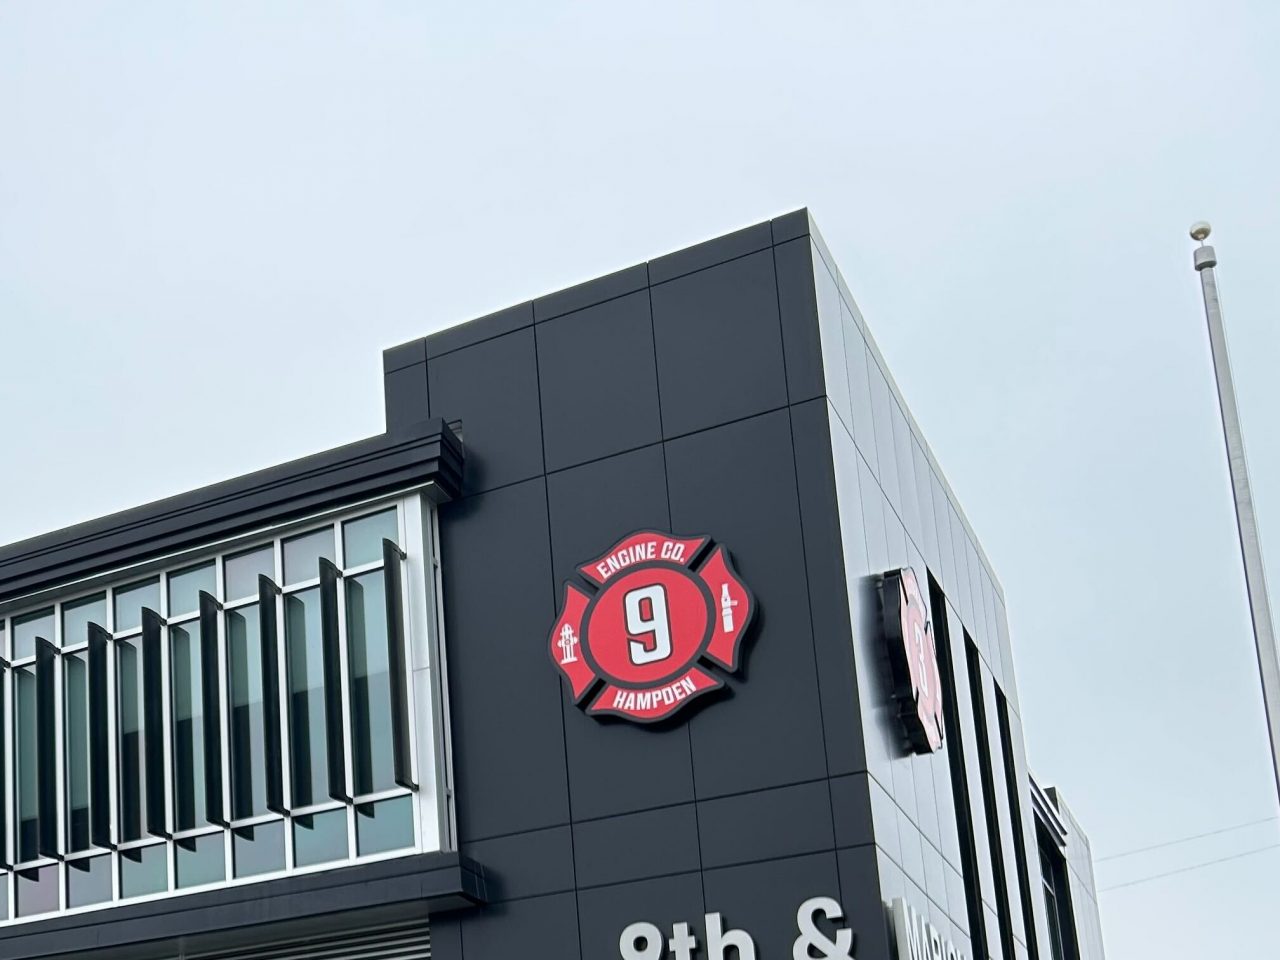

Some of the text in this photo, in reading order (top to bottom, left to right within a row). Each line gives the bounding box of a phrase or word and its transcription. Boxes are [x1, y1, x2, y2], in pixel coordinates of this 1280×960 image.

[596, 541, 685, 579] ENGINE CO.
[624, 583, 672, 666] 9
[612, 675, 697, 711] HAMPDEN
